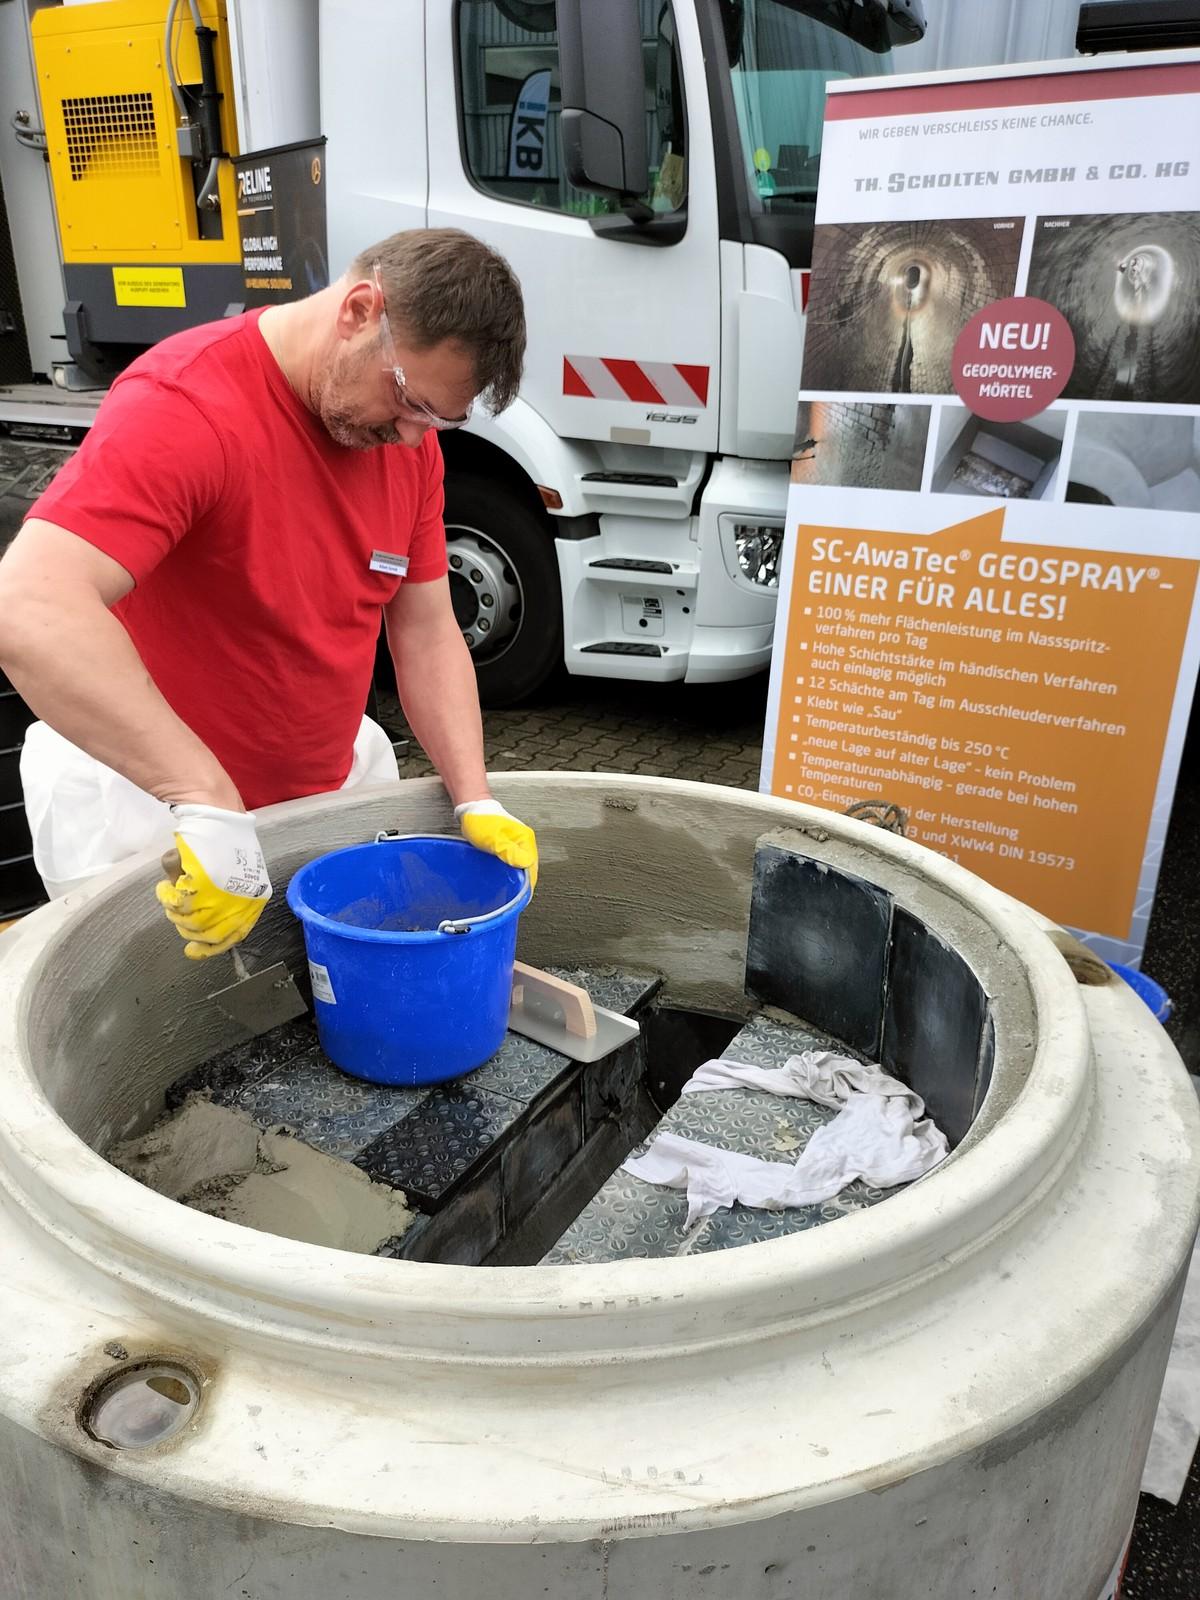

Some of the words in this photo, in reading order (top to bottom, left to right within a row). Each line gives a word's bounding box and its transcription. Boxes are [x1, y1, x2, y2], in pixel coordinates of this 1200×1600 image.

[859, 128, 879, 141] WIR
[883, 125, 919, 138] GEBEN
[923, 119, 998, 135] VERSCHLEISS
[1002, 117, 1037, 129] KEINE
[1040, 113, 1094, 127] CHANCE.
[238, 166, 272, 199] RELINE
[854, 178, 882, 192] TH.
[1008, 167, 1076, 184] GMBH
[1085, 166, 1099, 181] &
[1108, 164, 1147, 180] CO.
[242, 237, 262, 252] GLOBAL
[262, 235, 278, 251] HIGH
[244, 256, 283, 271] PERFORMANCE
[979, 323, 1051, 350] NEU!
[962, 364, 1057, 379] GEOPOLYMER-
[979, 381, 1033, 399] MÖRTEL
[646, 412, 698, 424] 1635
[808, 570, 888, 601] EINER
[897, 576, 955, 608] FÜR
[963, 586, 1067, 621] ALLES!
[815, 623, 875, 641] verfahren
[879, 632, 900, 644] pro
[905, 632, 928, 649] Tag
[817, 606, 842, 620] 100
[859, 612, 891, 627] mehr
[895, 614, 1002, 643] Flächenleistung
[1006, 628, 1023, 642] im
[1027, 630, 1110, 654] Nassspritz-
[811, 658, 839, 671] auch
[843, 663, 892, 681] einlagig
[896, 670, 946, 687] möglich
[813, 641, 845, 657] Hohe
[849, 646, 935, 669] Schichtstärke
[939, 658, 955, 672] im
[959, 660, 1039, 684] händischen
[1044, 672, 1118, 695] Verfahren
[807, 695, 838, 711] Klebt
[842, 702, 864, 715] wie
[809, 676, 825, 690] 12
[829, 678, 885, 698] Schächte
[888, 690, 908, 702] am
[912, 691, 935, 709] Tag
[939, 696, 955, 710] im
[959, 698, 1126, 736] Ausschleuderverfahren
[805, 714, 937, 750] Temperaturbeständig
[941, 737, 960, 751] bis
[964, 740, 992, 757] 250
[800, 766, 883, 793] Temperaturen
[842, 740, 871, 757] Lage
[875, 747, 896, 760] auf
[899, 751, 929, 766] alter
[984, 765, 1013, 781] kein
[1018, 770, 1077, 793] Problem
[802, 752, 943, 791] Temperaturunabhängig
[956, 783, 1003, 800] gerade
[1007, 790, 1029, 805] bei
[1033, 794, 1078, 814] hohen
[915, 808, 937, 823] der
[940, 813, 1019, 841] Herstellung
[922, 829, 947, 844] und
[950, 834, 995, 853] XWW4
[999, 844, 1024, 860] DIN
[1028, 850, 1076, 871] 19573
